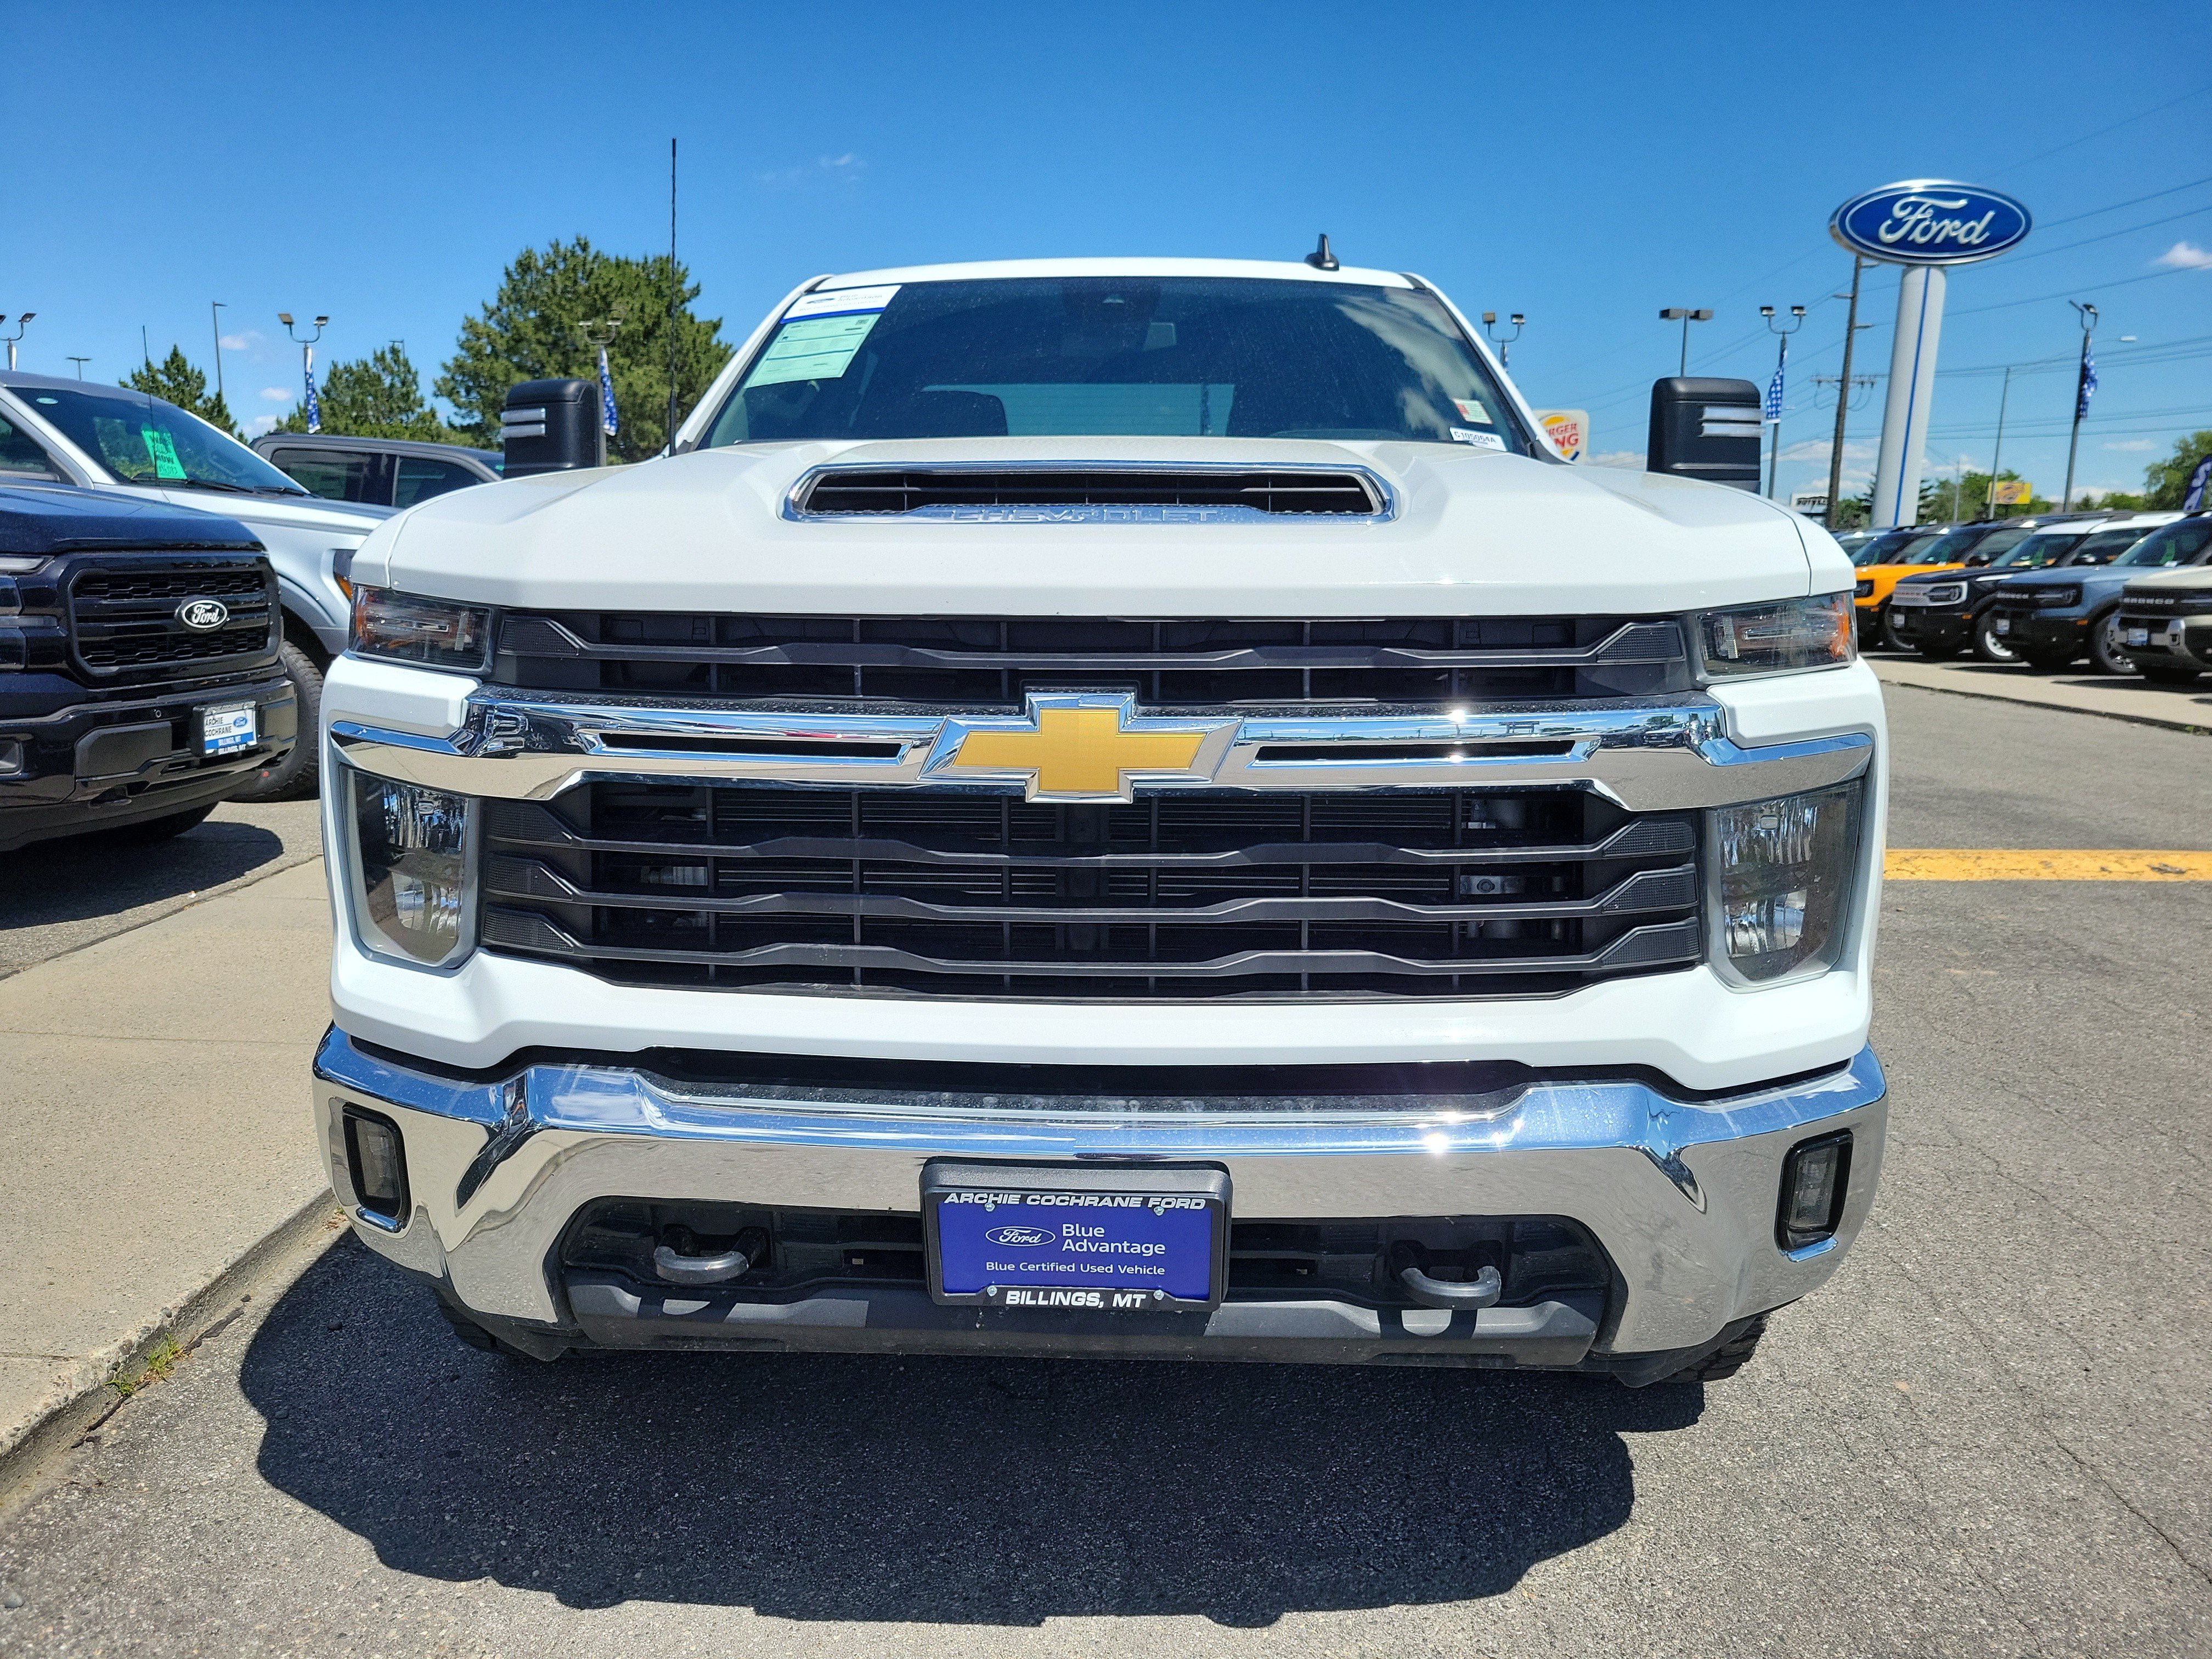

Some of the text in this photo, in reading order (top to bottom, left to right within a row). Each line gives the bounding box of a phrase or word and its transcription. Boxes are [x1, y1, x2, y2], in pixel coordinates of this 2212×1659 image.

[1878, 195, 1996, 245] Ford
[1546, 423, 1577, 436] RGER
[1553, 432, 1578, 447] NG
[952, 509, 1218, 522] CHEVROLET
[191, 604, 219, 624] Ford
[206, 716, 224, 726] ARCHIE
[205, 725, 232, 737] COCHRANE
[944, 1193, 1206, 1210] ARCHIE COCHRANE FORD
[998, 1223, 1105, 1244] Ford Blue
[1062, 1238, 1166, 1256] Advantage
[986, 1261, 1165, 1275] Blue Certified Used Vehicle
[1005, 1290, 1146, 1308] BILLINGS, MT
